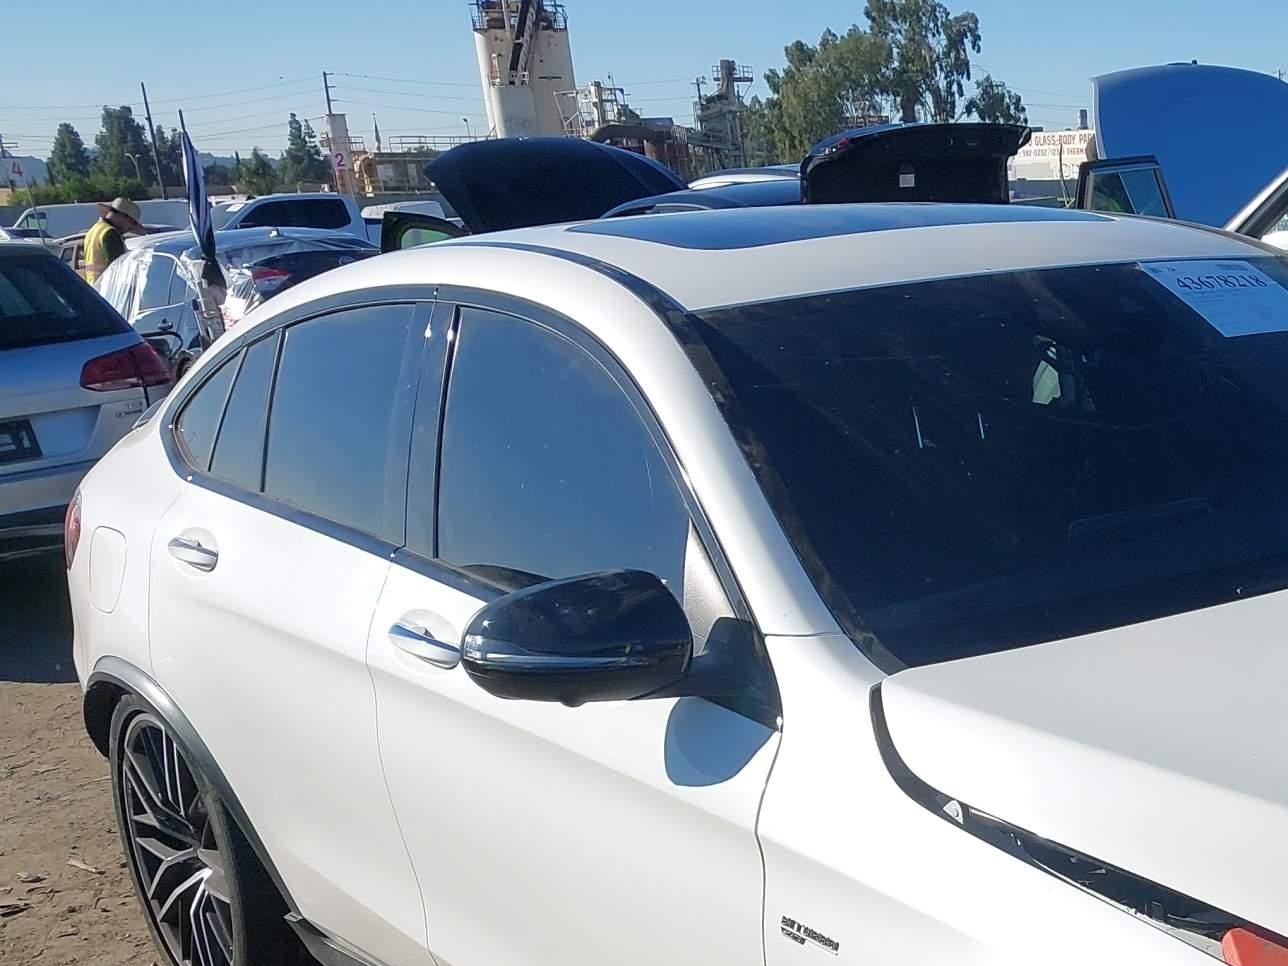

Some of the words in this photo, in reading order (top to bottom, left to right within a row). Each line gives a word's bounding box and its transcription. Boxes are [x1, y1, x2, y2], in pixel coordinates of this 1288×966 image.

[335, 153, 346, 167] 2
[12, 160, 24, 177] 4
[1176, 275, 1268, 290] 43678218
